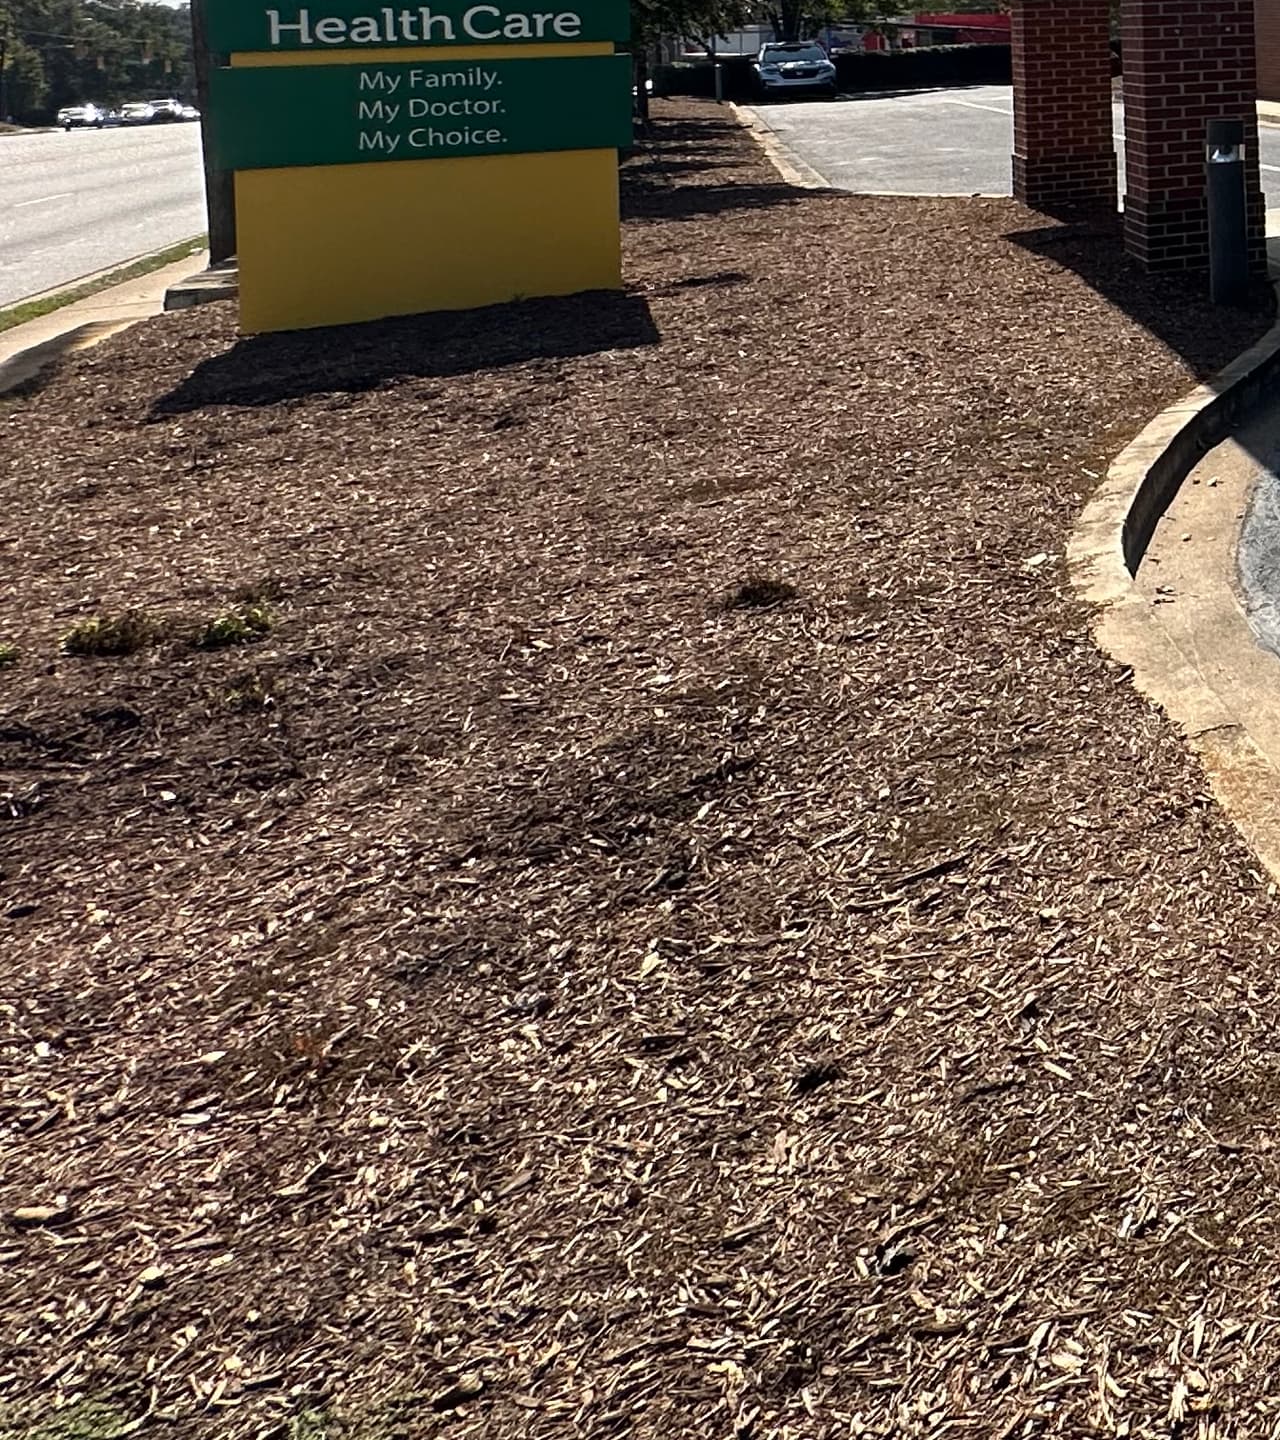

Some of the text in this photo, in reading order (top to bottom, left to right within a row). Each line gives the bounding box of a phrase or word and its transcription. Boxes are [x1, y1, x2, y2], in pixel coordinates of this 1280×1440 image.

[265, 5, 582, 45] Health Care
[359, 67, 503, 94] My Family.
[358, 98, 506, 124] My Doctor.
[358, 126, 508, 154] My Choice.
